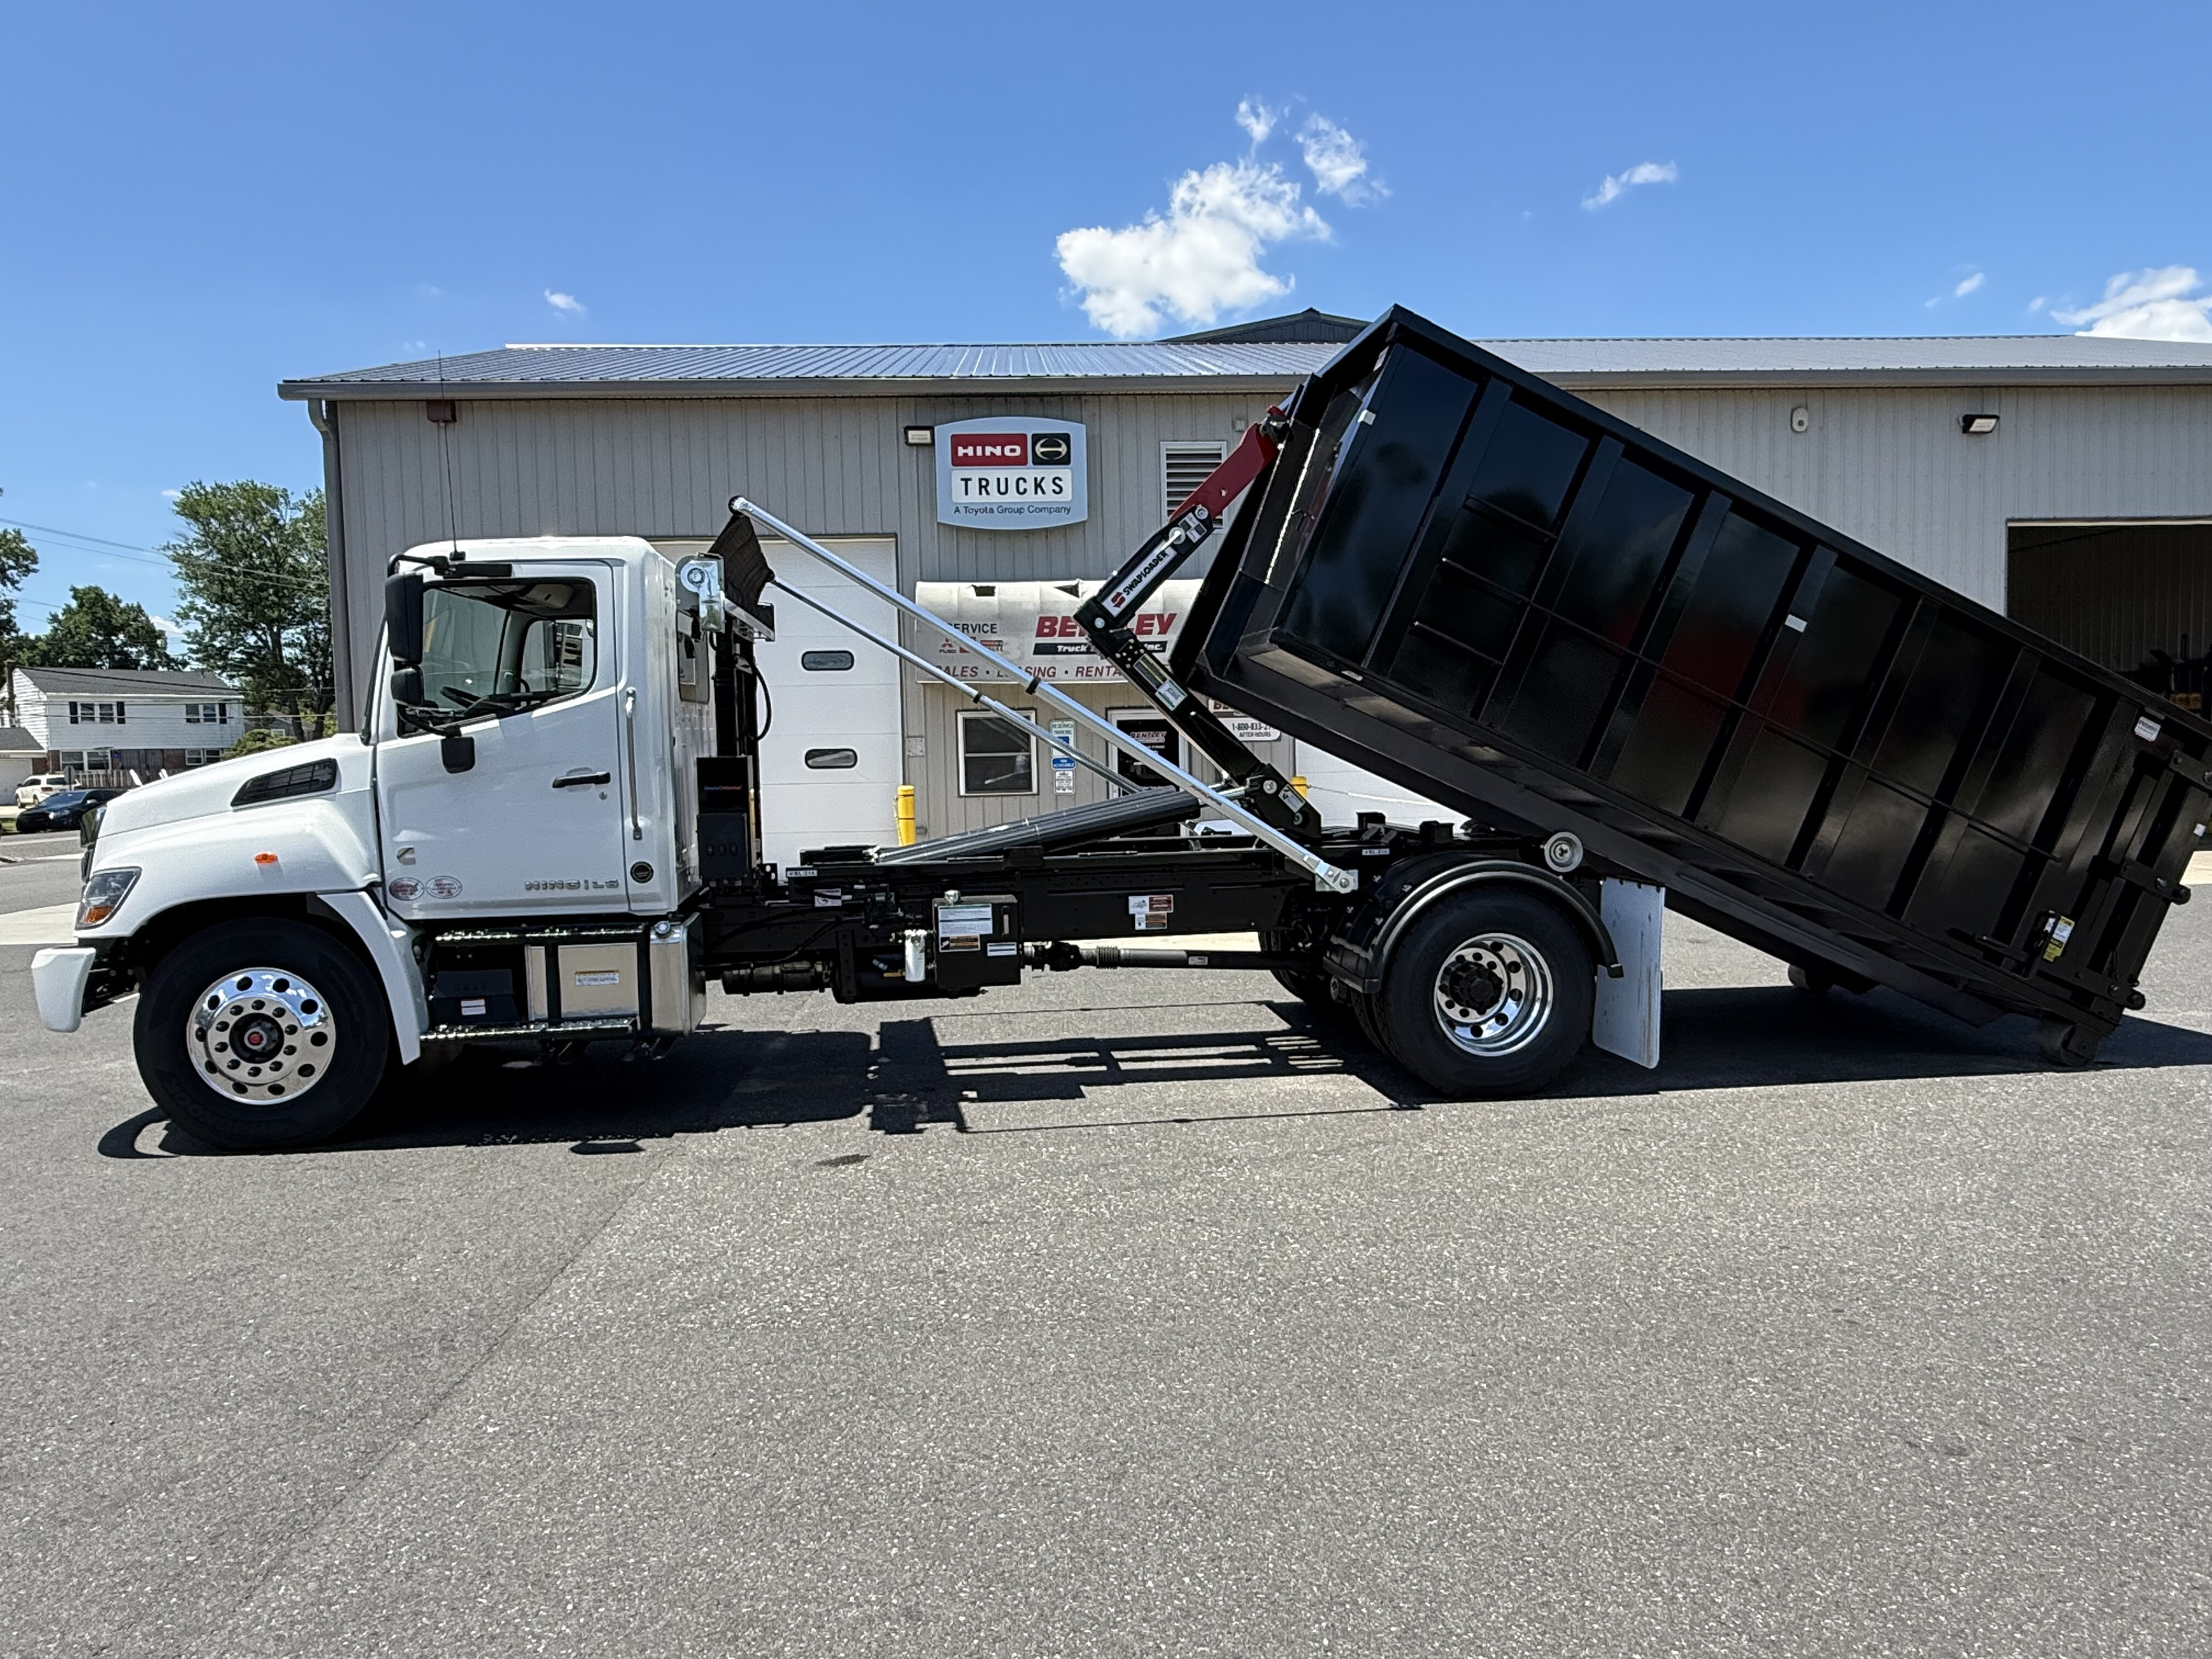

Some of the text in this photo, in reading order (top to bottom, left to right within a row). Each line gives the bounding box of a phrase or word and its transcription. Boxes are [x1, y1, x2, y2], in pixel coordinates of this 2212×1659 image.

[957, 445, 1021, 456] HINO
[961, 477, 1063, 496] TRUCKS
[963, 506, 994, 516] Toyota
[997, 506, 1024, 516] Group
[1028, 505, 1071, 515] Company
[1122, 550, 1169, 595] SWAPLOADER
[1035, 613, 1177, 637] BEEY
[997, 666, 1057, 677] LSING
[1075, 666, 1124, 677] RENTA
[525, 879, 580, 890] HINO
